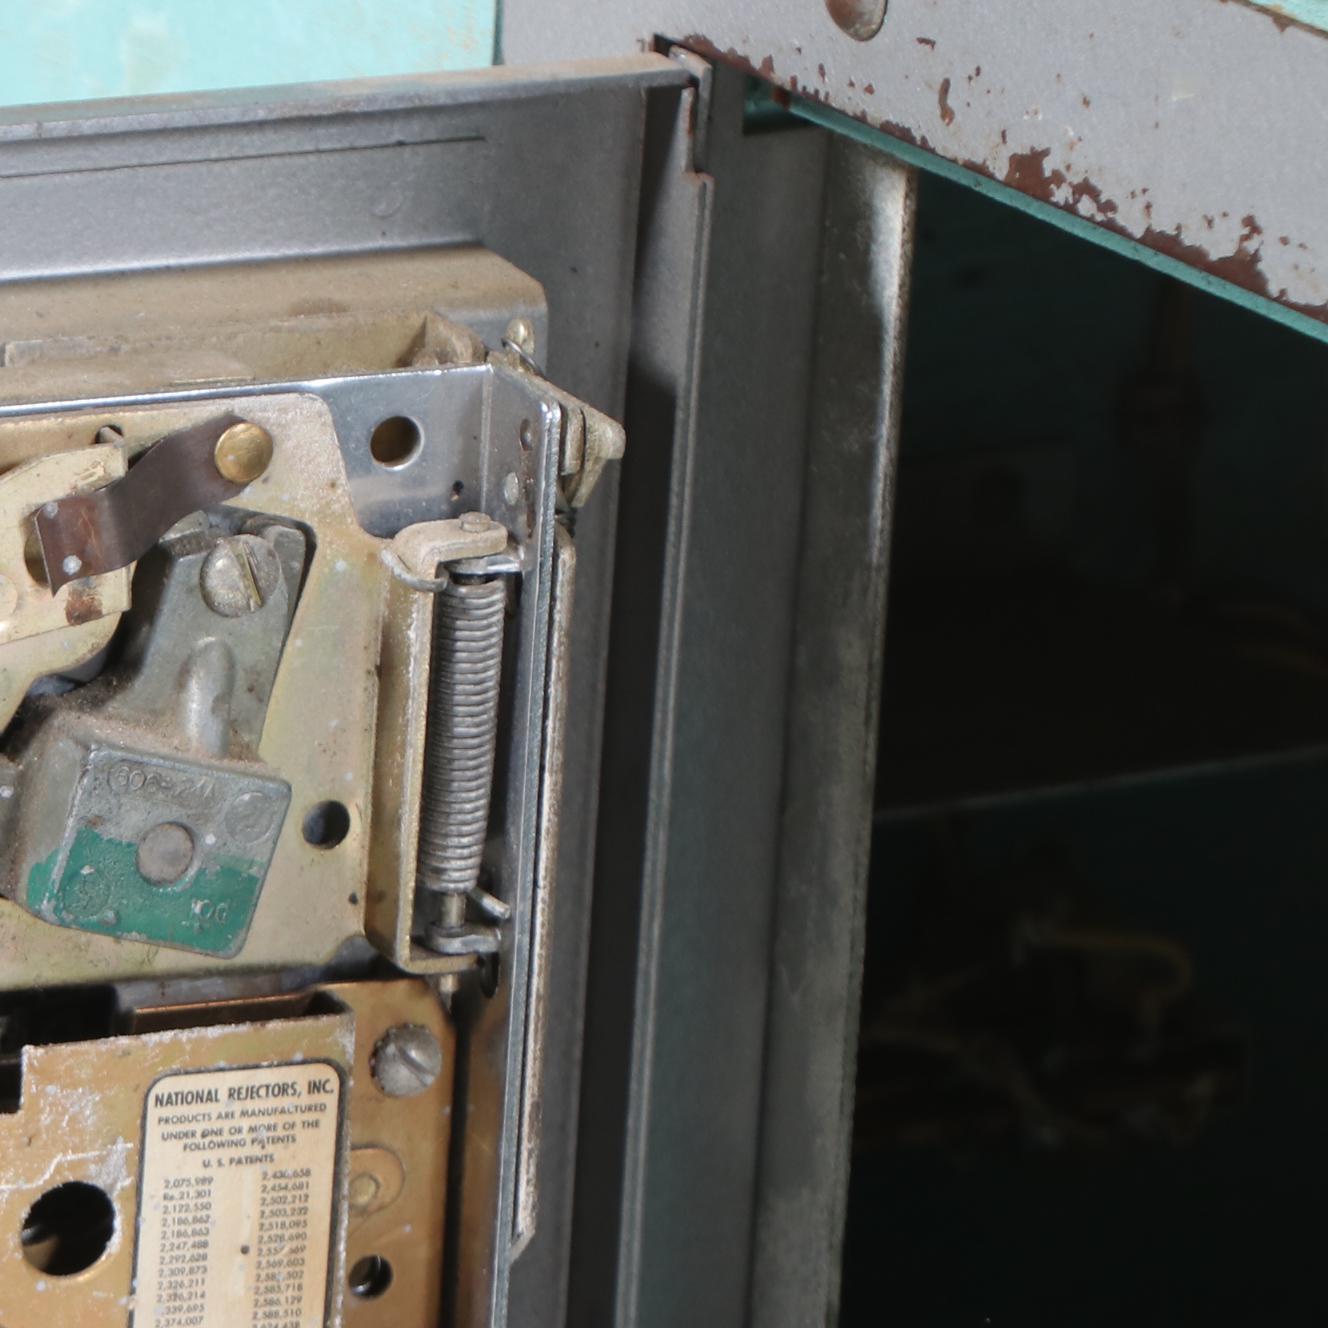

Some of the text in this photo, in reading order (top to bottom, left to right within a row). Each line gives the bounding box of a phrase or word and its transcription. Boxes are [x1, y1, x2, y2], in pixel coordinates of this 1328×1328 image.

[155, 1078, 334, 1108] NATIONAL REJECTORS, INC.
[158, 1103, 326, 1125] PRODUCTS ARE MANUFACTURED
[162, 1119, 320, 1141] UNDER ONE OR MORE OF THE
[183, 1137, 246, 1151] FOLLOWING
[203, 1159, 212, 1168] U.
[229, 1154, 274, 1165] PATENTS
